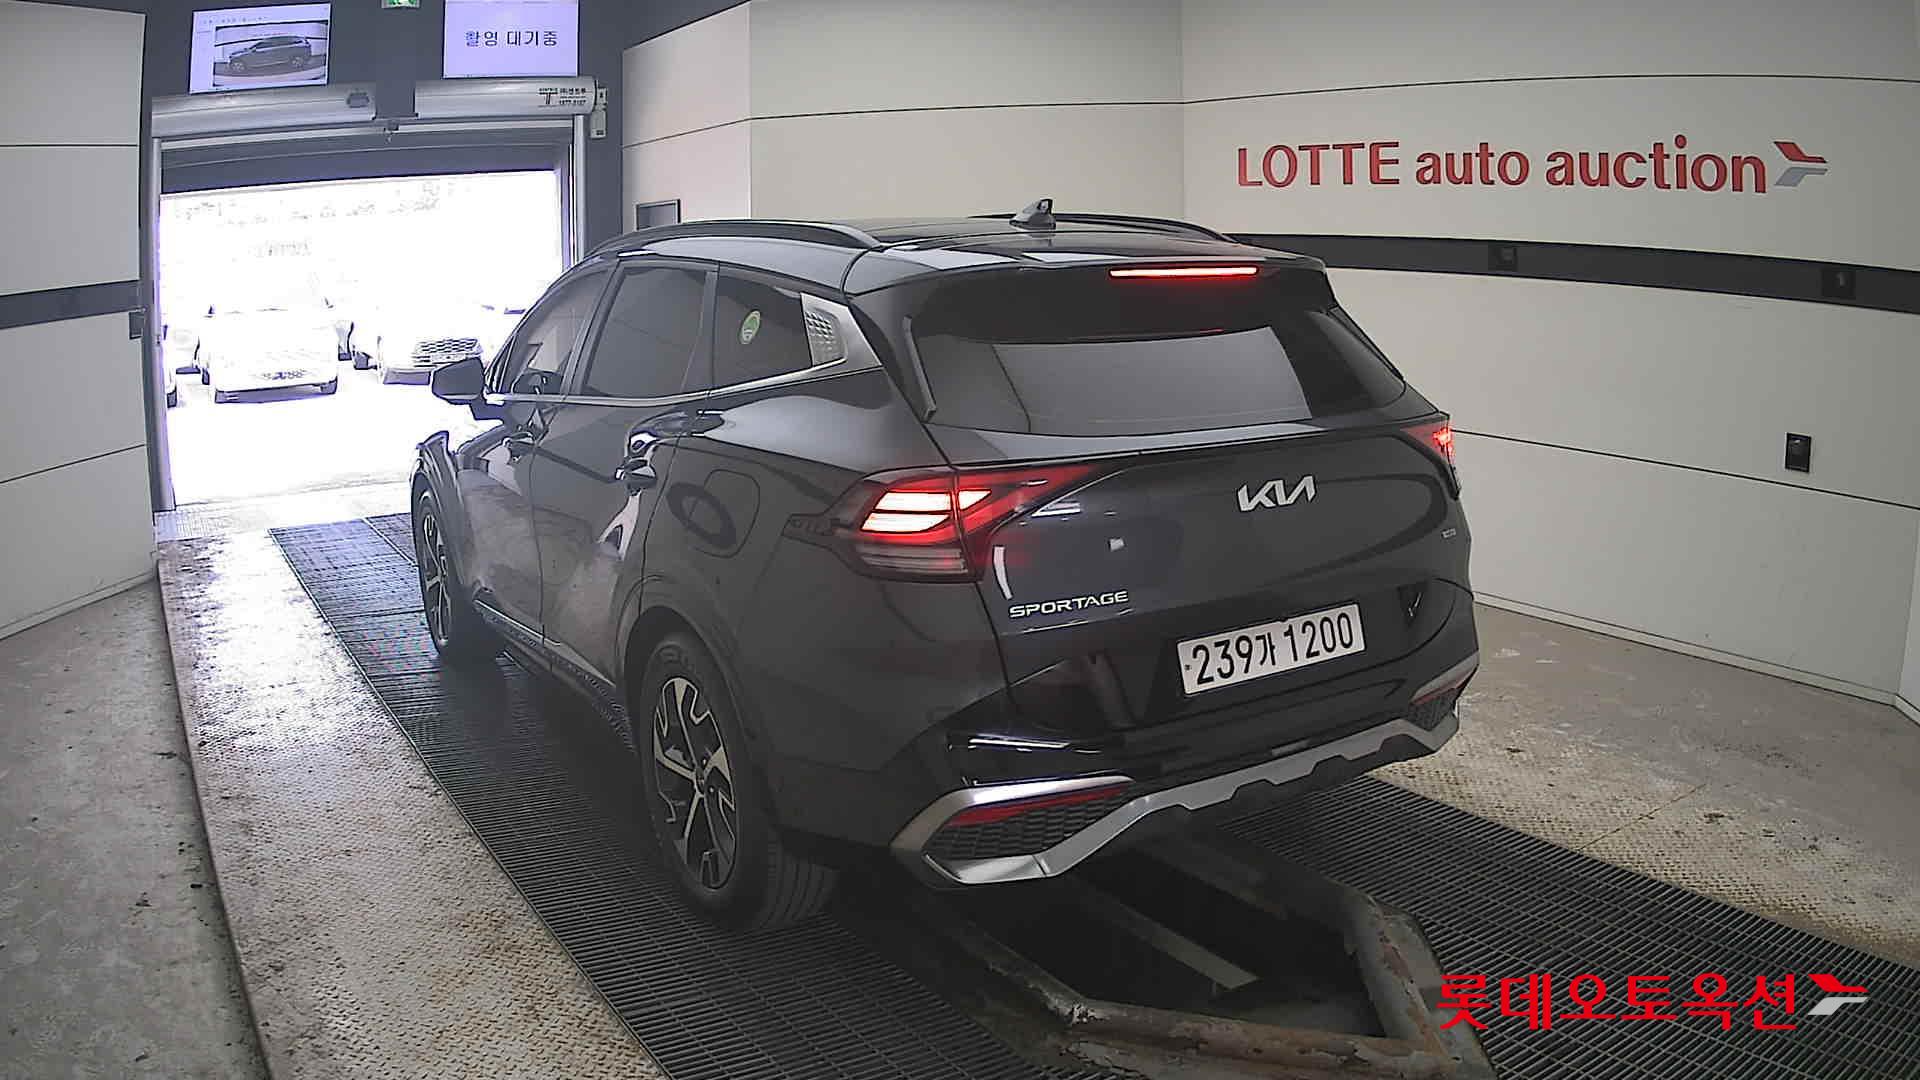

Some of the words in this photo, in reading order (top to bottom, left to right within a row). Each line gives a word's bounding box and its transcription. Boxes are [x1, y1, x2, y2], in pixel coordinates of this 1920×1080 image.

[507, 31, 557, 47] 대기중
[1237, 141, 1400, 188] LOTTE
[1415, 142, 1530, 186] auto
[1545, 134, 1767, 193] auction
[1238, 475, 1316, 512] KIA
[1009, 590, 1129, 618] SPORTAGE
[1192, 631, 1276, 686] 239가
[1283, 612, 1354, 662] 1200
